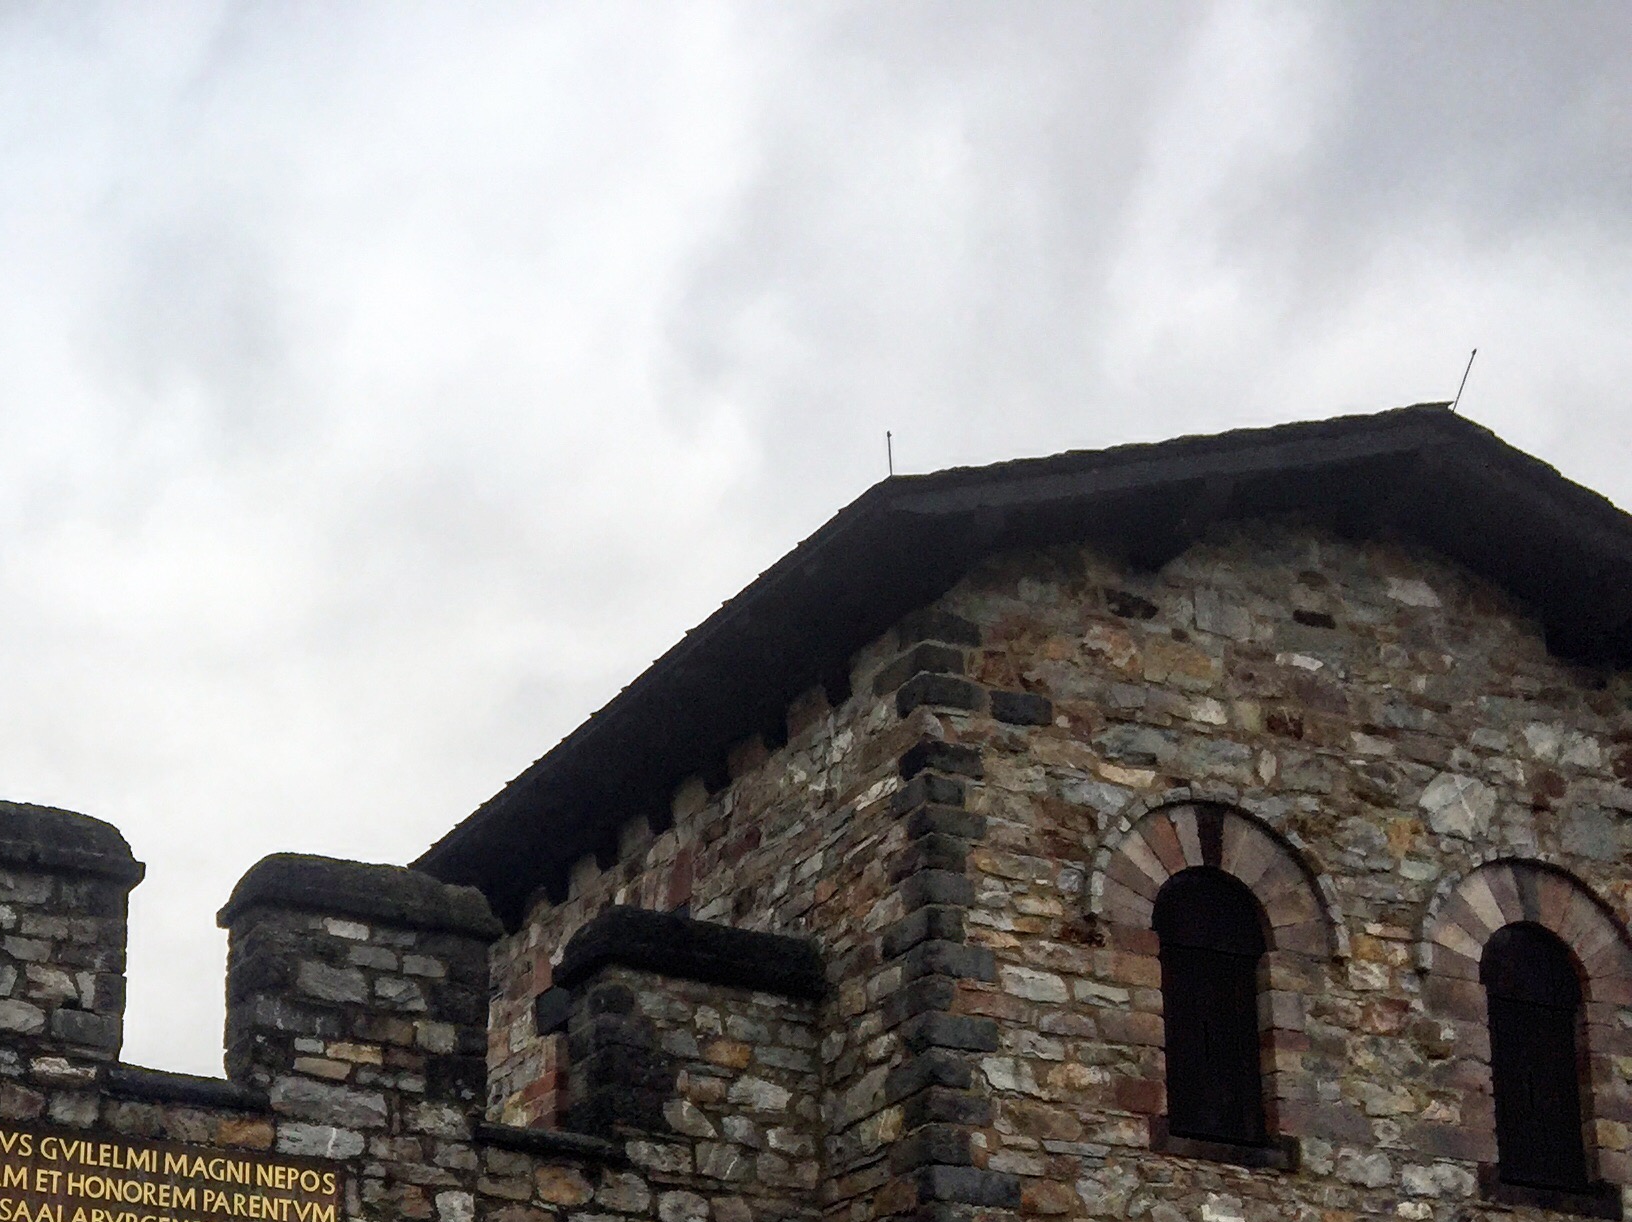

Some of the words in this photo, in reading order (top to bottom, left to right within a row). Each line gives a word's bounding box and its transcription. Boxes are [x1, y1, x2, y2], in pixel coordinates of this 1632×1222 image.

[35, 1168, 63, 1194] ET
[67, 1172, 196, 1211] HONOREM
[40, 1137, 158, 1173] GVILELMI
[163, 1152, 251, 1185] MAGNI
[256, 1163, 336, 1195] NEPOS
